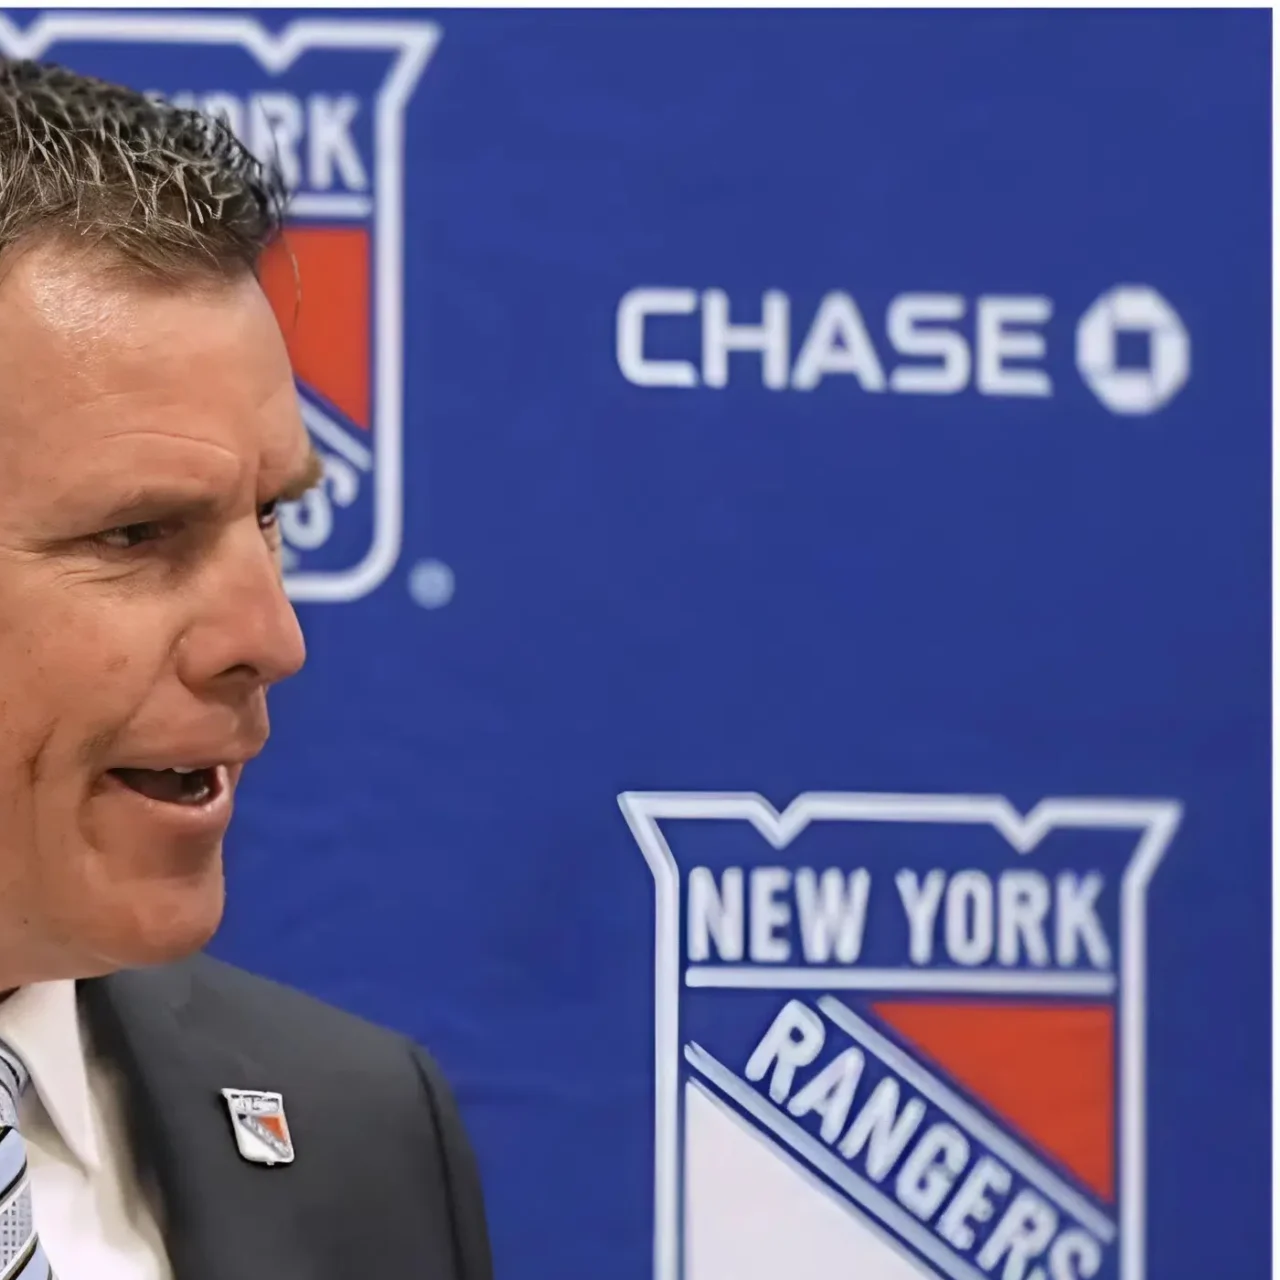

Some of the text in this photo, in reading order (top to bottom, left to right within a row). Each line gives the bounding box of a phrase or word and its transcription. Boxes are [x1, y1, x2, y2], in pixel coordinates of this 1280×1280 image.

[616, 287, 1054, 397] CHASE
[687, 866, 1112, 969] NEW YORK
